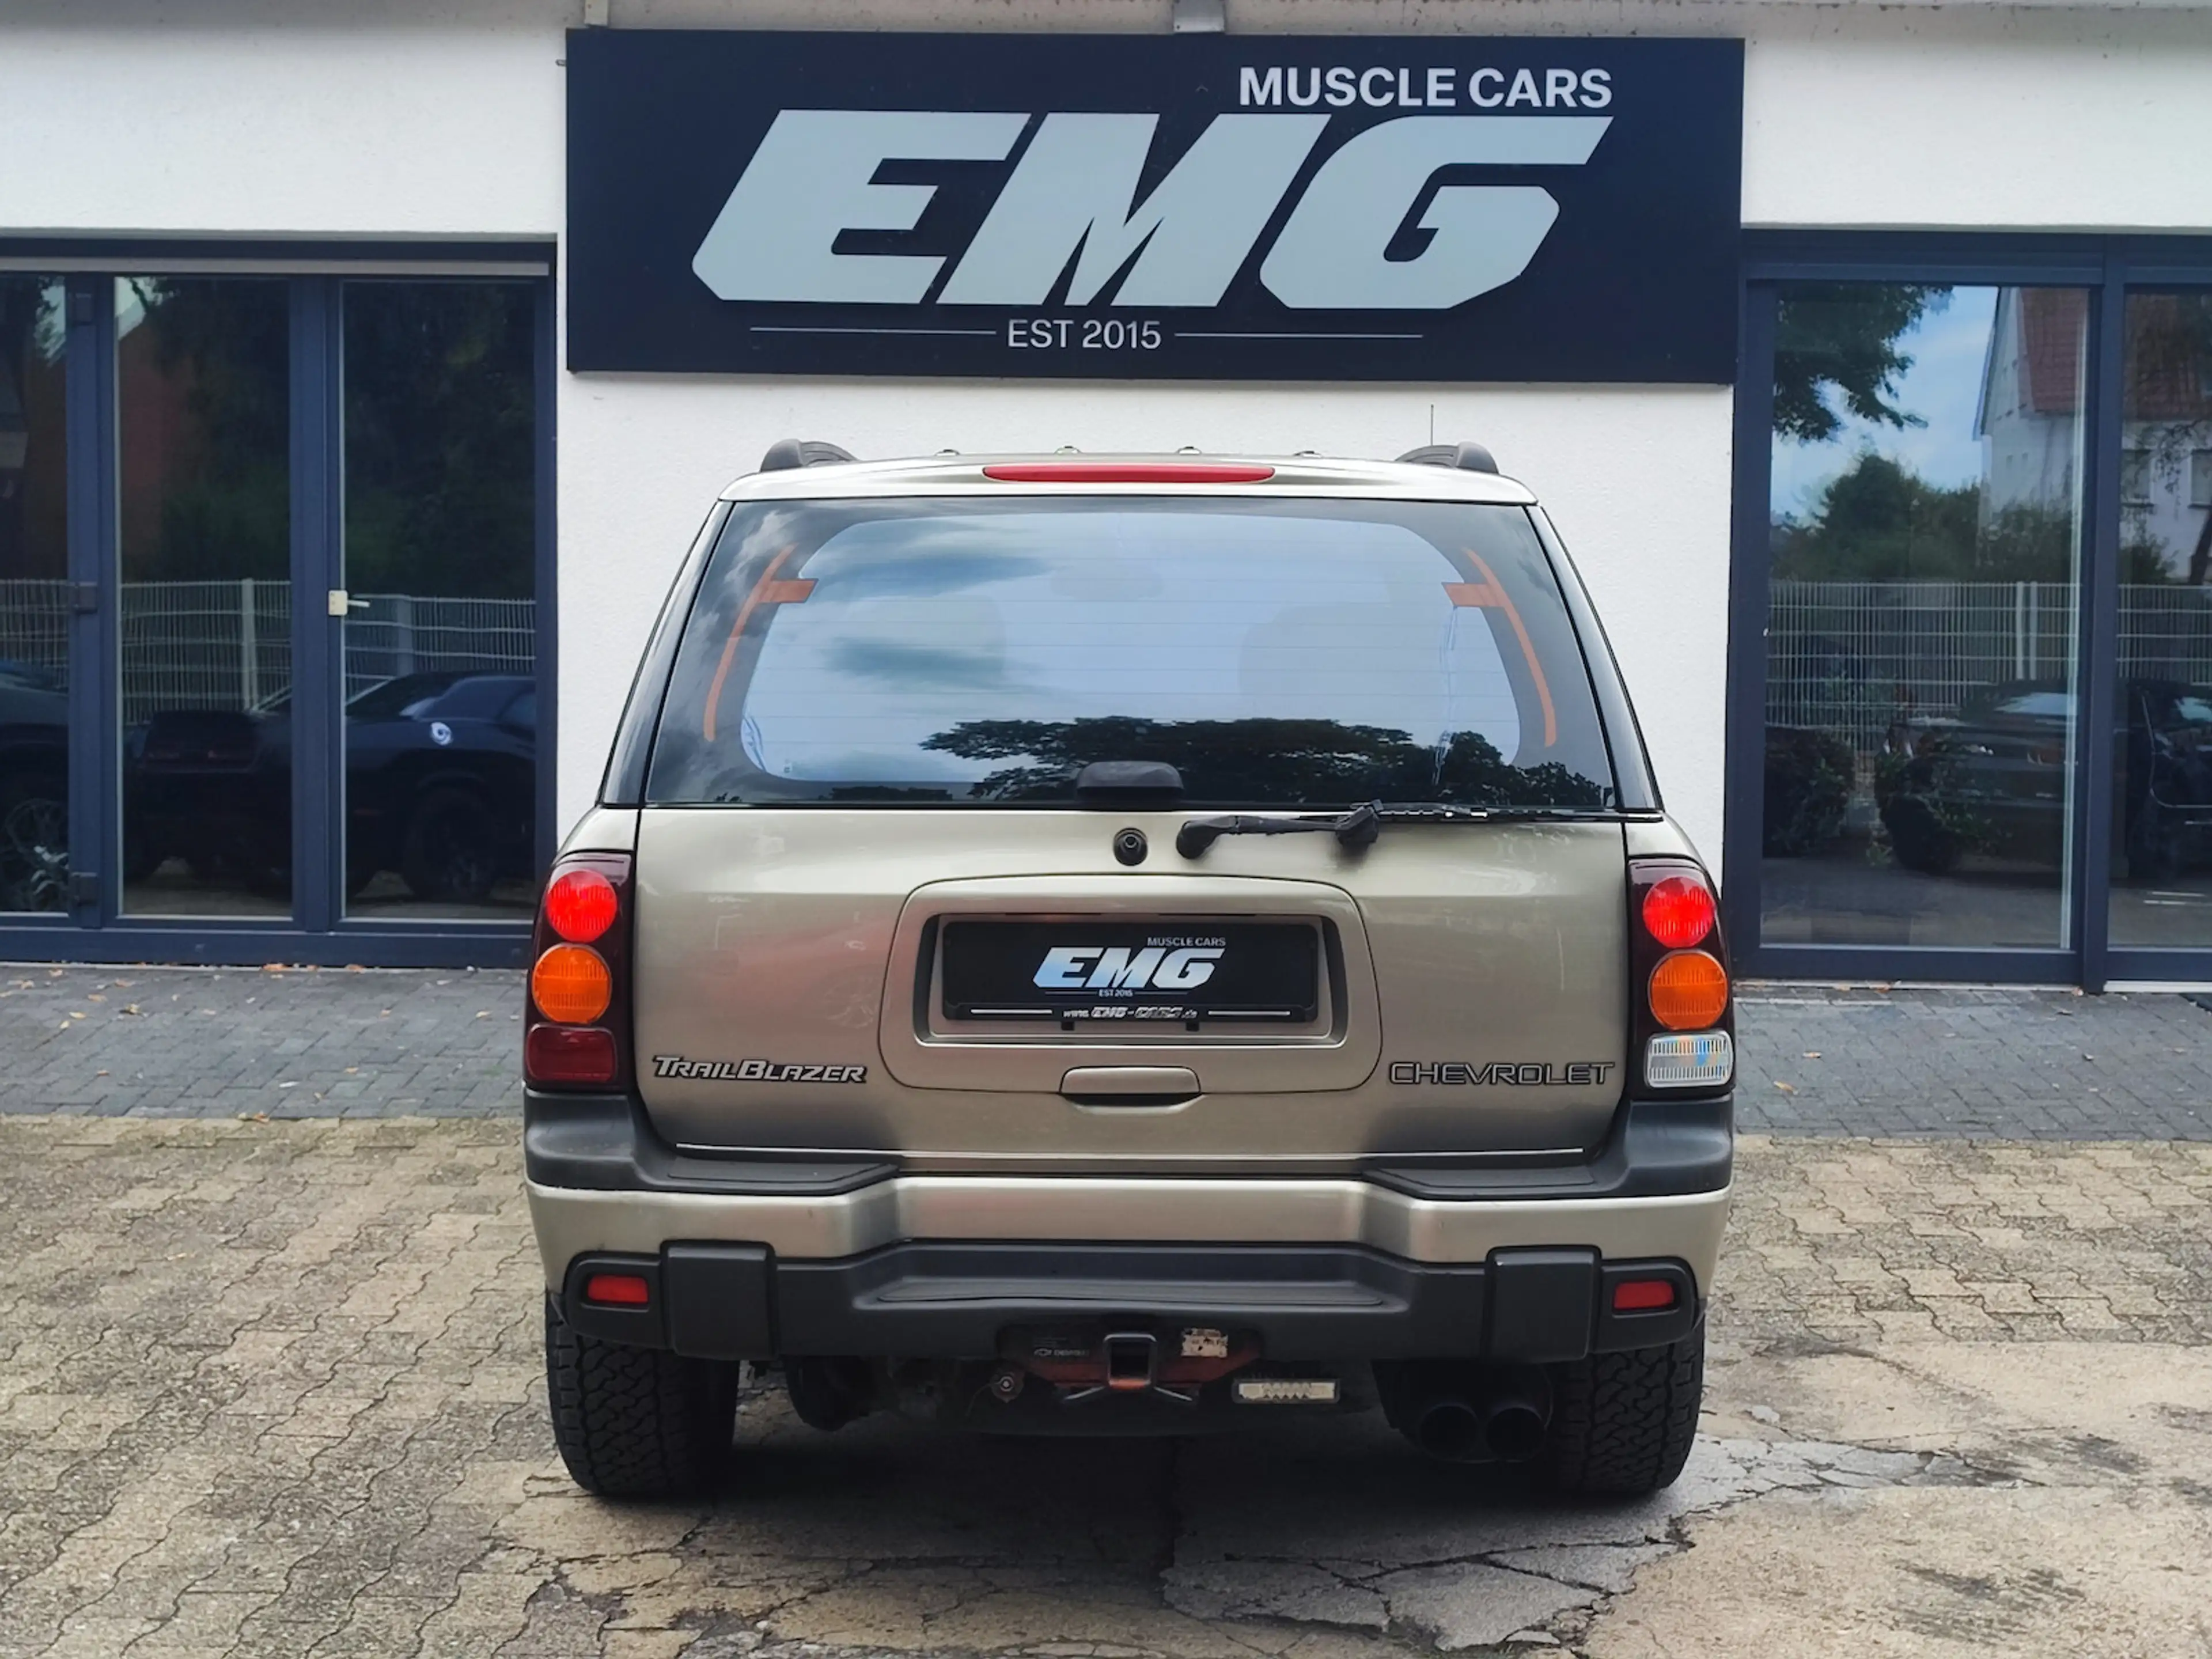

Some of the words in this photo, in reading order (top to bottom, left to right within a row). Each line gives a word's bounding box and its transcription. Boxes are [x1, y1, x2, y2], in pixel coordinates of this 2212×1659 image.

[1240, 67, 1456, 107] MUSCLE
[1469, 68, 1612, 108] CARS
[692, 109, 1613, 309] EMG
[1008, 320, 1073, 348] EST
[1082, 320, 1161, 349] 2015
[1147, 937, 1194, 946] MUSCLE
[1195, 937, 1226, 946] CARS
[1033, 948, 1225, 988] EMG
[653, 1055, 867, 1084] TRAILBLAZER
[1389, 1062, 1615, 1085] CHEVROLET
